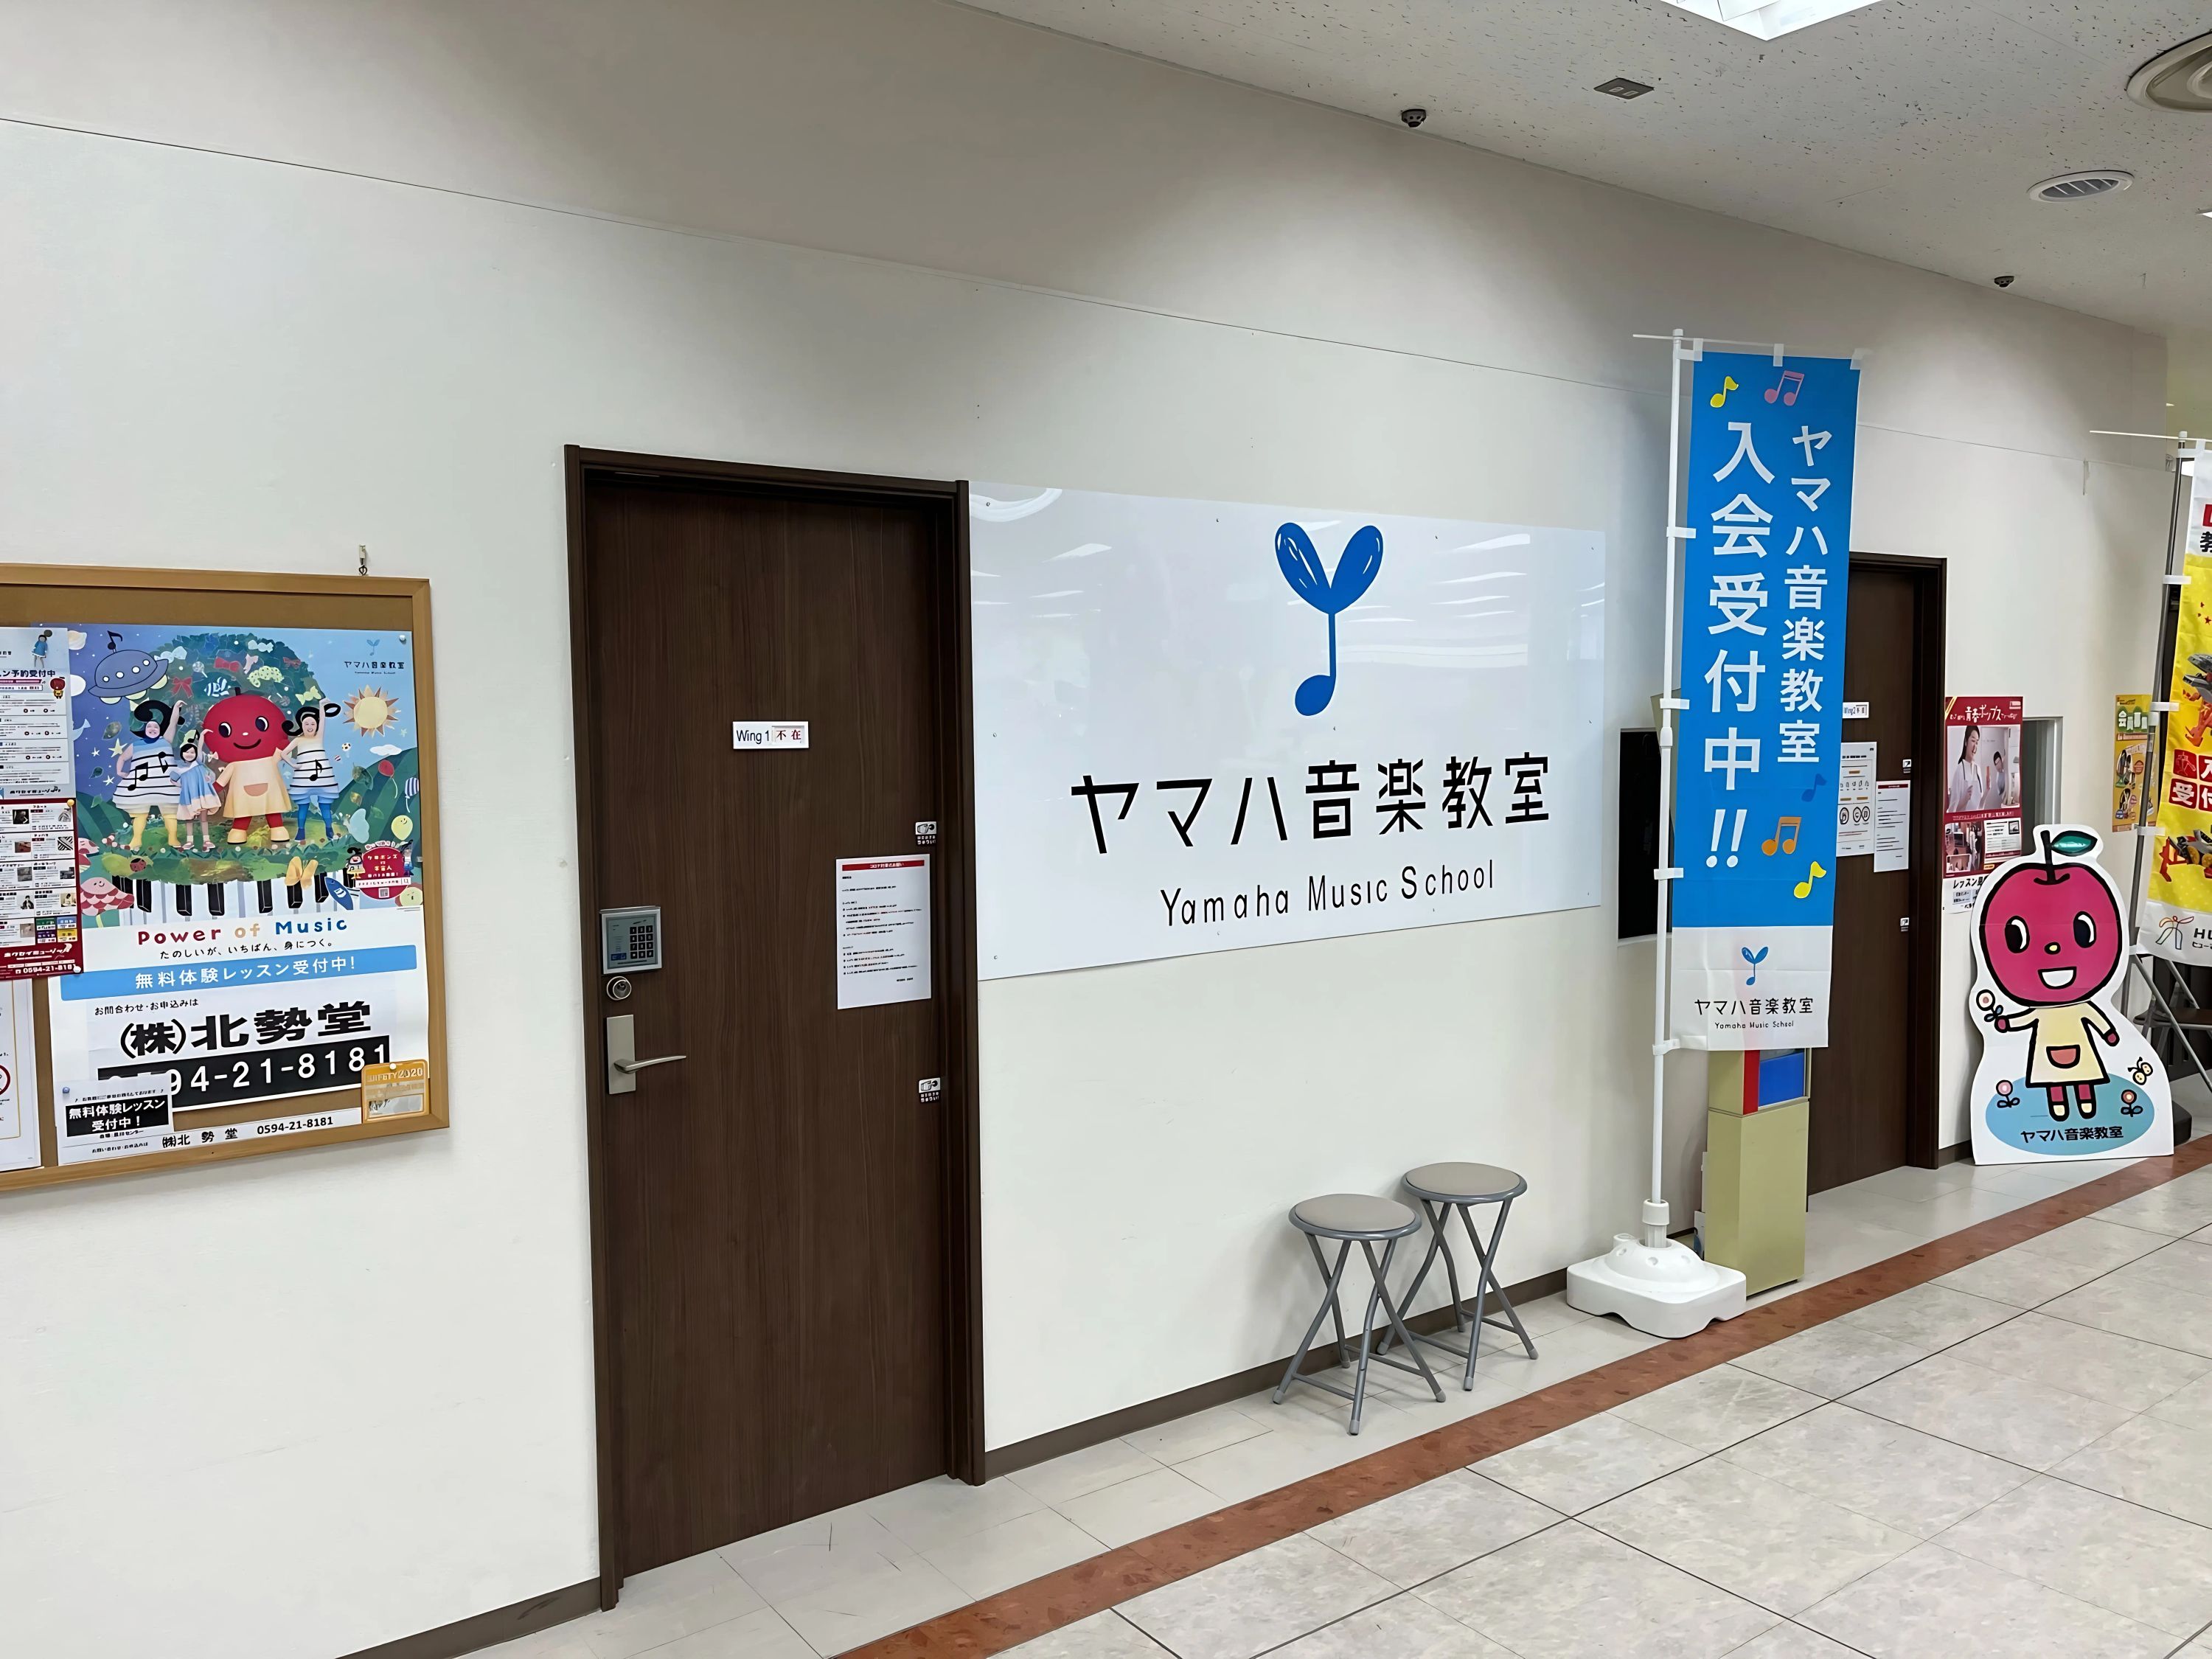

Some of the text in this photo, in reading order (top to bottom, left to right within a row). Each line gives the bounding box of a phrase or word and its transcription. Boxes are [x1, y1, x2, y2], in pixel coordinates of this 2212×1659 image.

[1777, 425, 1832, 762] ヤマハ音楽教室
[736, 729, 762, 744] Wing
[765, 730, 769, 742] 1
[1071, 751, 1550, 854] ヤマハ音楽教室
[1161, 860, 1494, 927] Yamaha Music School
[138, 918, 347, 945] Power of Music
[1694, 997, 1813, 1015] ヤマハ音楽教室
[108, 1043, 386, 1096] 94-21-8181
[257, 1116, 333, 1135] 0594-21-8181
[2020, 1125, 2124, 1144] ヤマハ音楽教室
